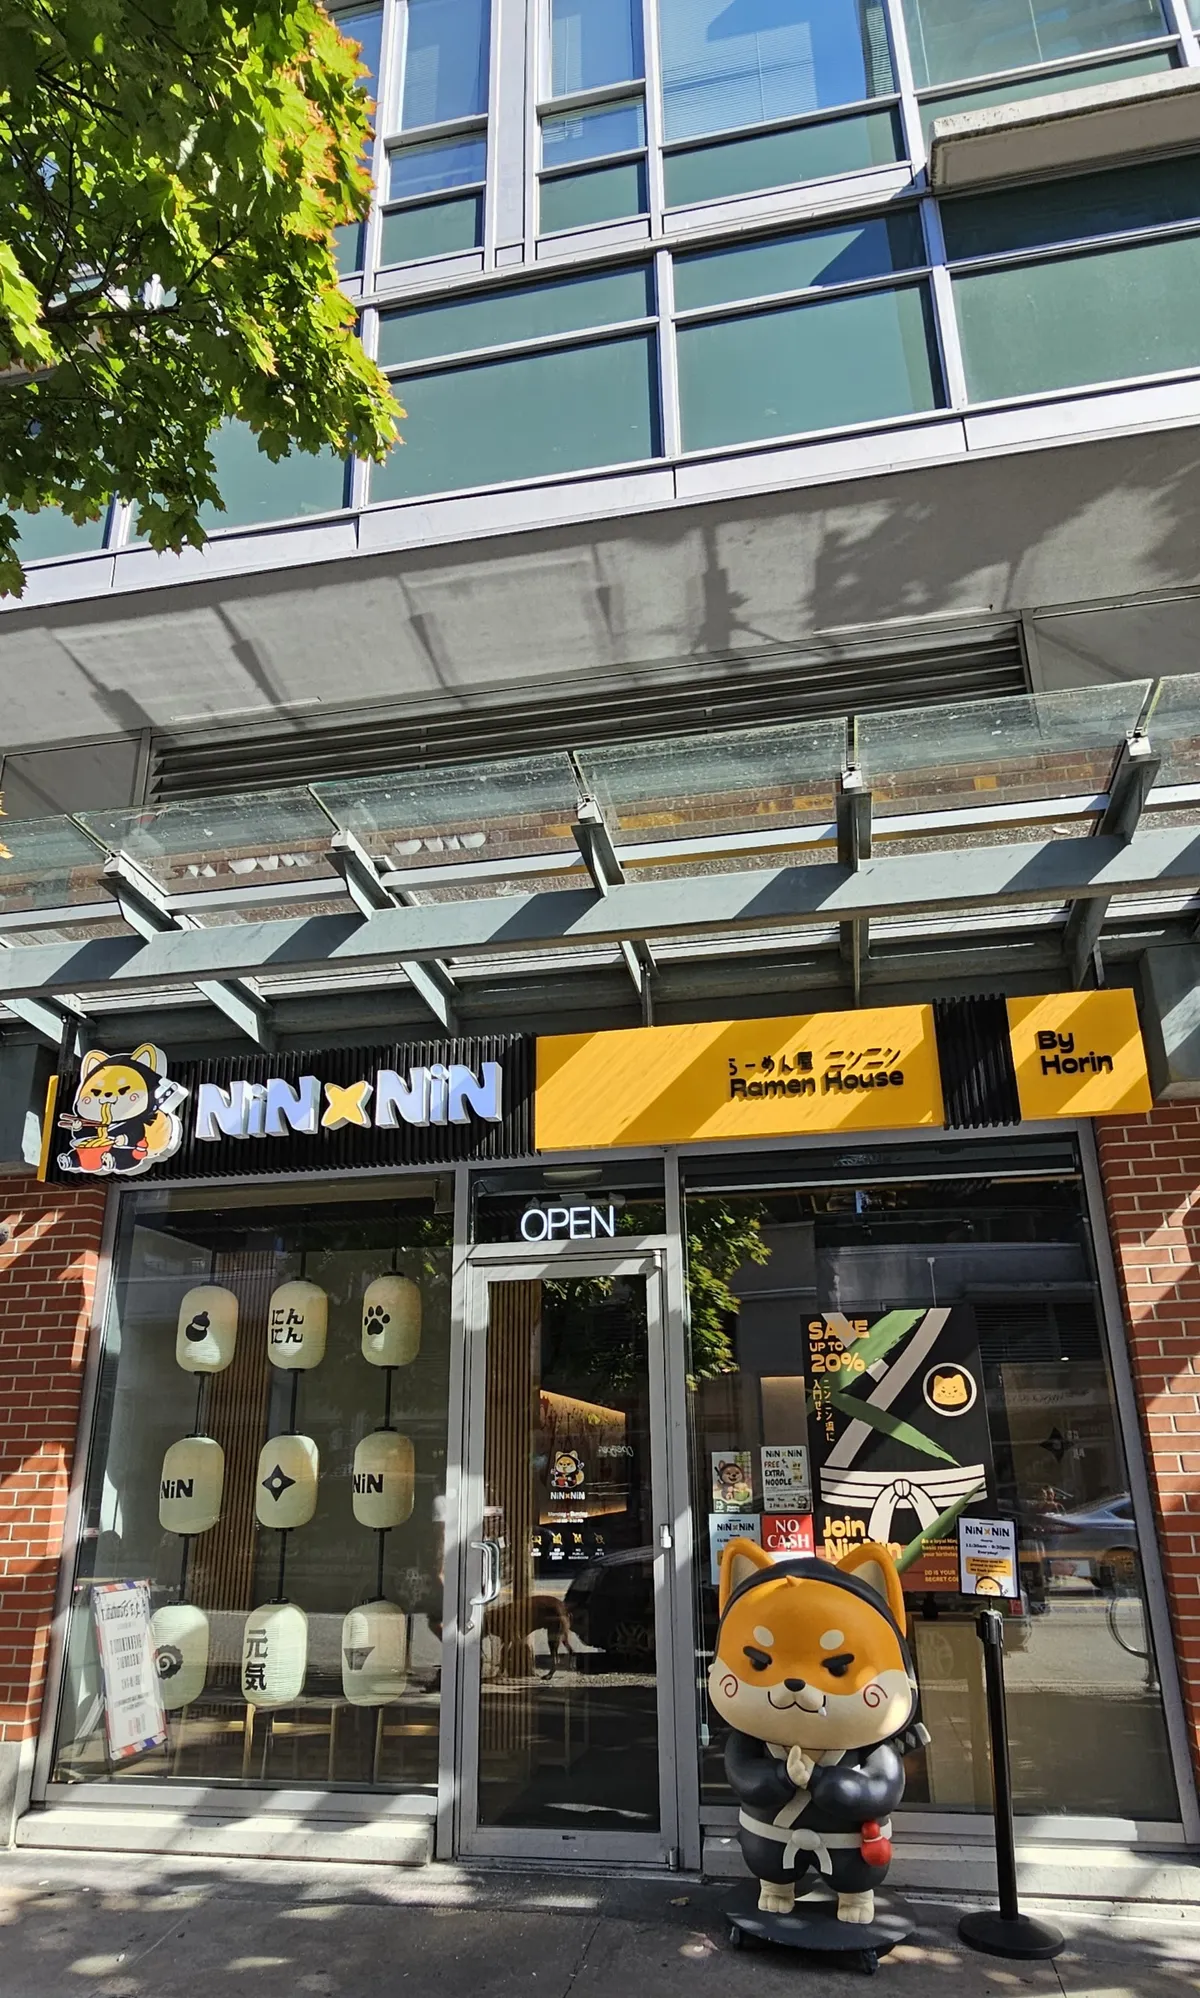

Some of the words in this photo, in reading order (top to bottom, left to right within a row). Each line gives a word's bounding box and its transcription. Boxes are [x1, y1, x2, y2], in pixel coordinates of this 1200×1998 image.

[1037, 1030, 1075, 1054] By
[728, 1050, 813, 1076] らーめん屋
[829, 1048, 901, 1070] ニンニン
[1040, 1051, 1113, 1075] Horin
[730, 1076, 816, 1098] Ramen
[824, 1070, 904, 1092] House
[195, 1075, 320, 1141] NiN
[375, 1061, 502, 1129] NiN
[521, 1204, 615, 1242] OPEN
[808, 1319, 870, 1340] SAVE
[809, 1342, 826, 1352] UP
[828, 1341, 844, 1352] TO
[811, 1352, 865, 1373] 20%
[765, 1469, 785, 1477] EXTRA
[765, 1478, 792, 1486] NOODLE
[776, 1520, 799, 1533] NO
[823, 1516, 865, 1537] Join
[767, 1534, 810, 1549] CASH
[244, 1628, 269, 1691] 元気
